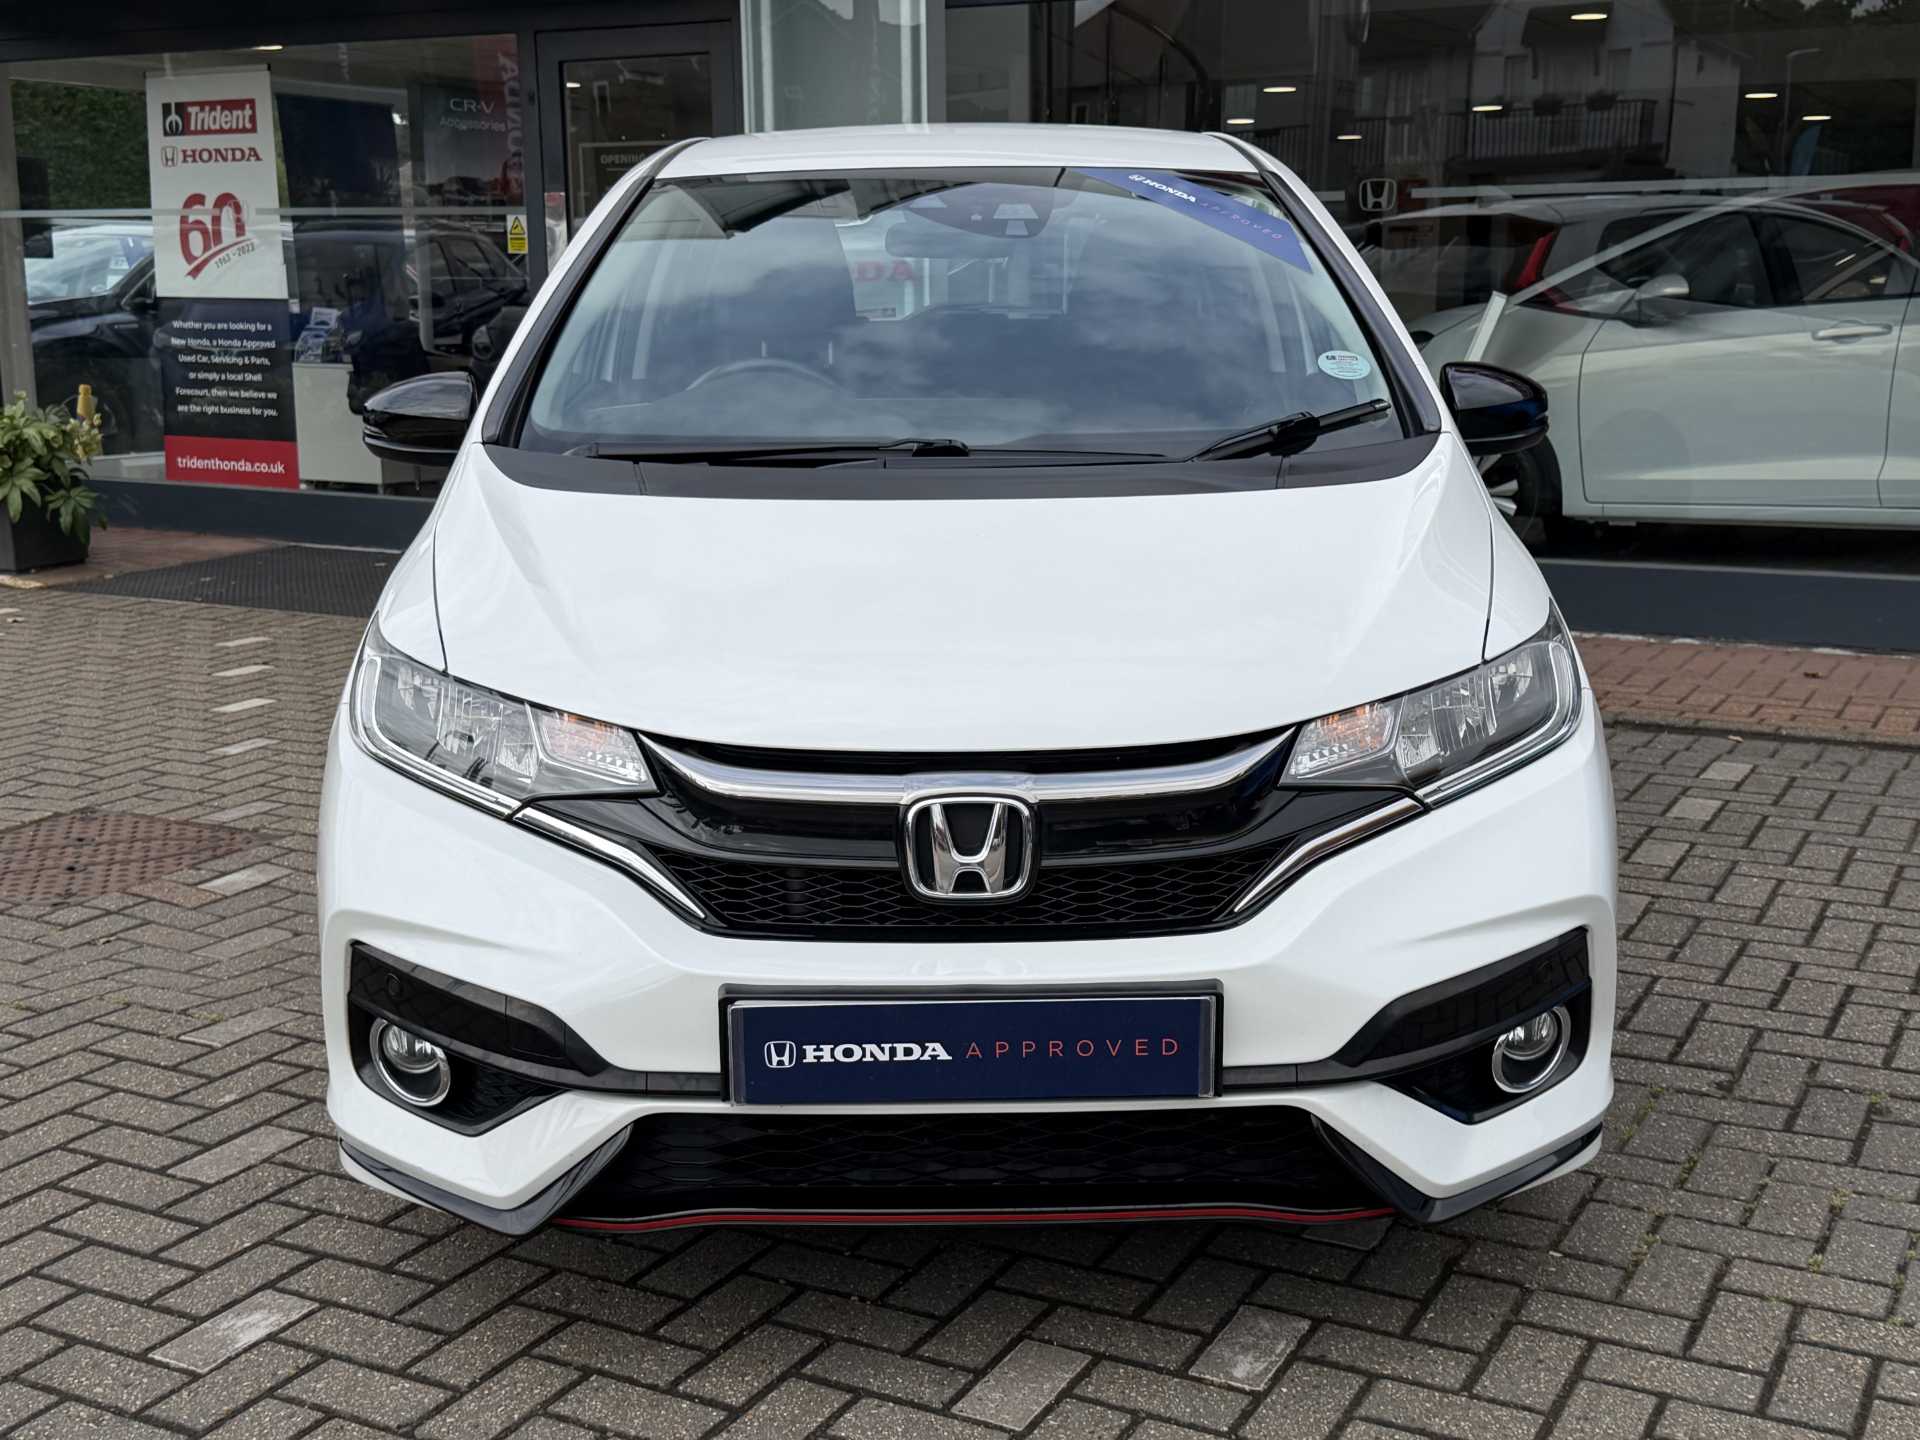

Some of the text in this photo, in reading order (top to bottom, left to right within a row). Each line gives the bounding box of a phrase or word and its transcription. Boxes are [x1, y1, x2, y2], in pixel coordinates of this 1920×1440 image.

[187, 103, 253, 131] Trident
[181, 146, 263, 164] HONDA
[1142, 178, 1196, 203] HONDA
[172, 320, 202, 329] Whether
[203, 322, 216, 332] you
[217, 322, 228, 330] are
[229, 320, 256, 332] looking
[256, 321, 266, 331] for
[171, 337, 186, 345] New
[218, 338, 241, 347] Honda
[242, 339, 276, 349] Approved
[178, 354, 196, 362] Used
[211, 354, 243, 366] Servicing
[197, 371, 220, 382] simply
[226, 372, 244, 381] local
[244, 372, 262, 382] Shell
[211, 387, 228, 397] then
[228, 390, 239, 398] we
[240, 388, 266, 399] believe
[267, 391, 278, 399] we
[177, 404, 189, 412] are
[189, 404, 202, 412] the
[202, 404, 219, 415] right
[220, 405, 251, 415] business
[252, 406, 262, 415] for
[176, 455, 285, 474] tridenthonda.co.uk
[802, 1041, 952, 1064] HONDA
[966, 1037, 1180, 1059] APPROVED
